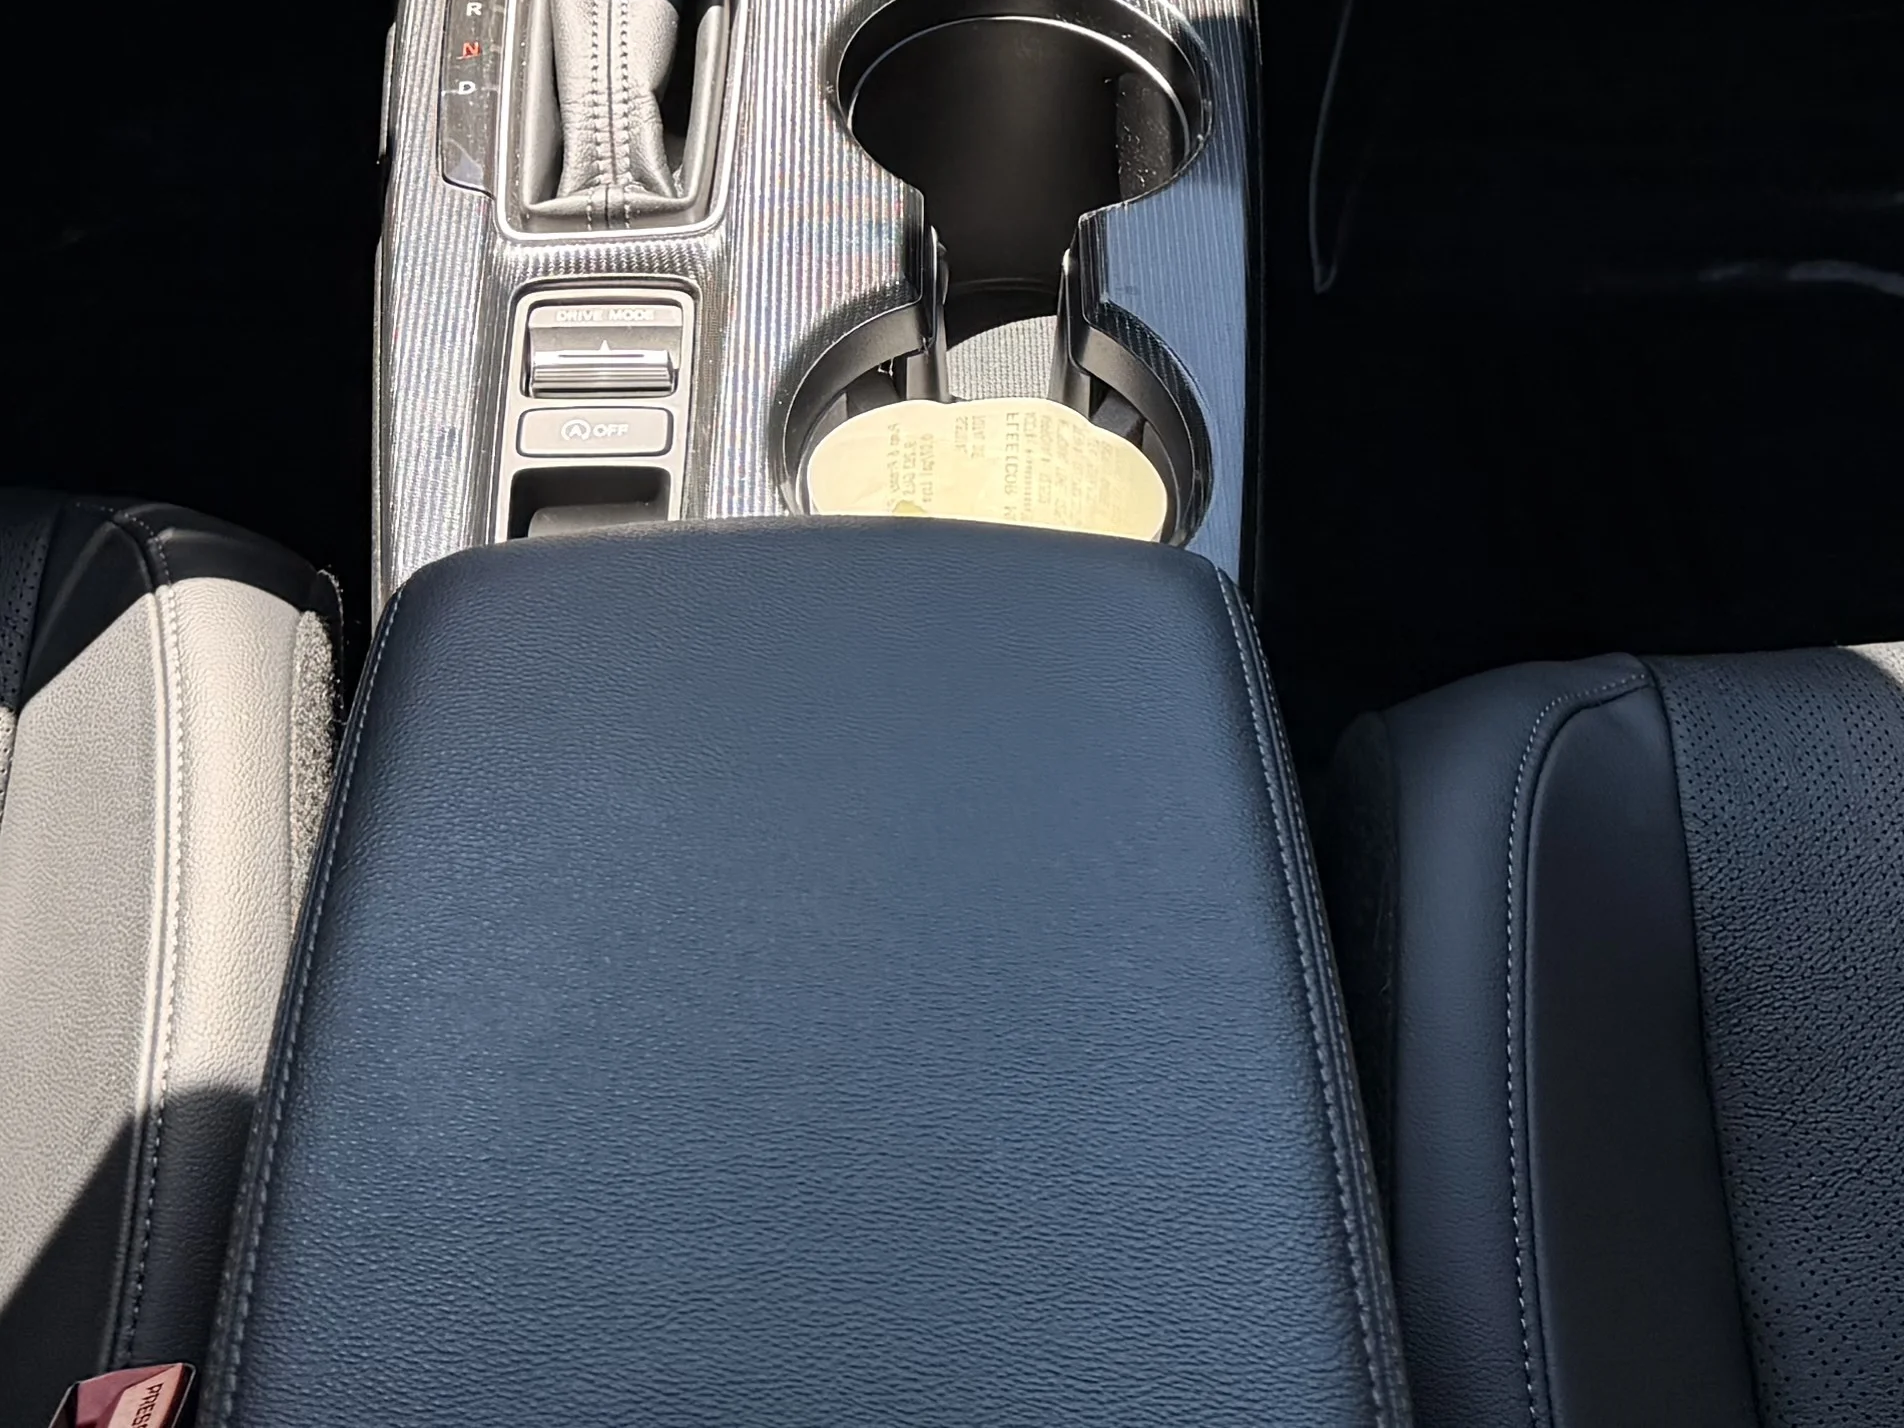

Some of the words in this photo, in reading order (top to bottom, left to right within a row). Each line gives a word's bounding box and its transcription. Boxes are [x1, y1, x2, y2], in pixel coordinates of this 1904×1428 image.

[466, 1, 483, 17] R
[461, 41, 481, 58] N
[458, 81, 477, 95] D
[556, 309, 603, 322] DRIVE
[608, 309, 655, 321] MODE
[592, 423, 629, 437] OFF
[131, 1382, 164, 1428] PRES
